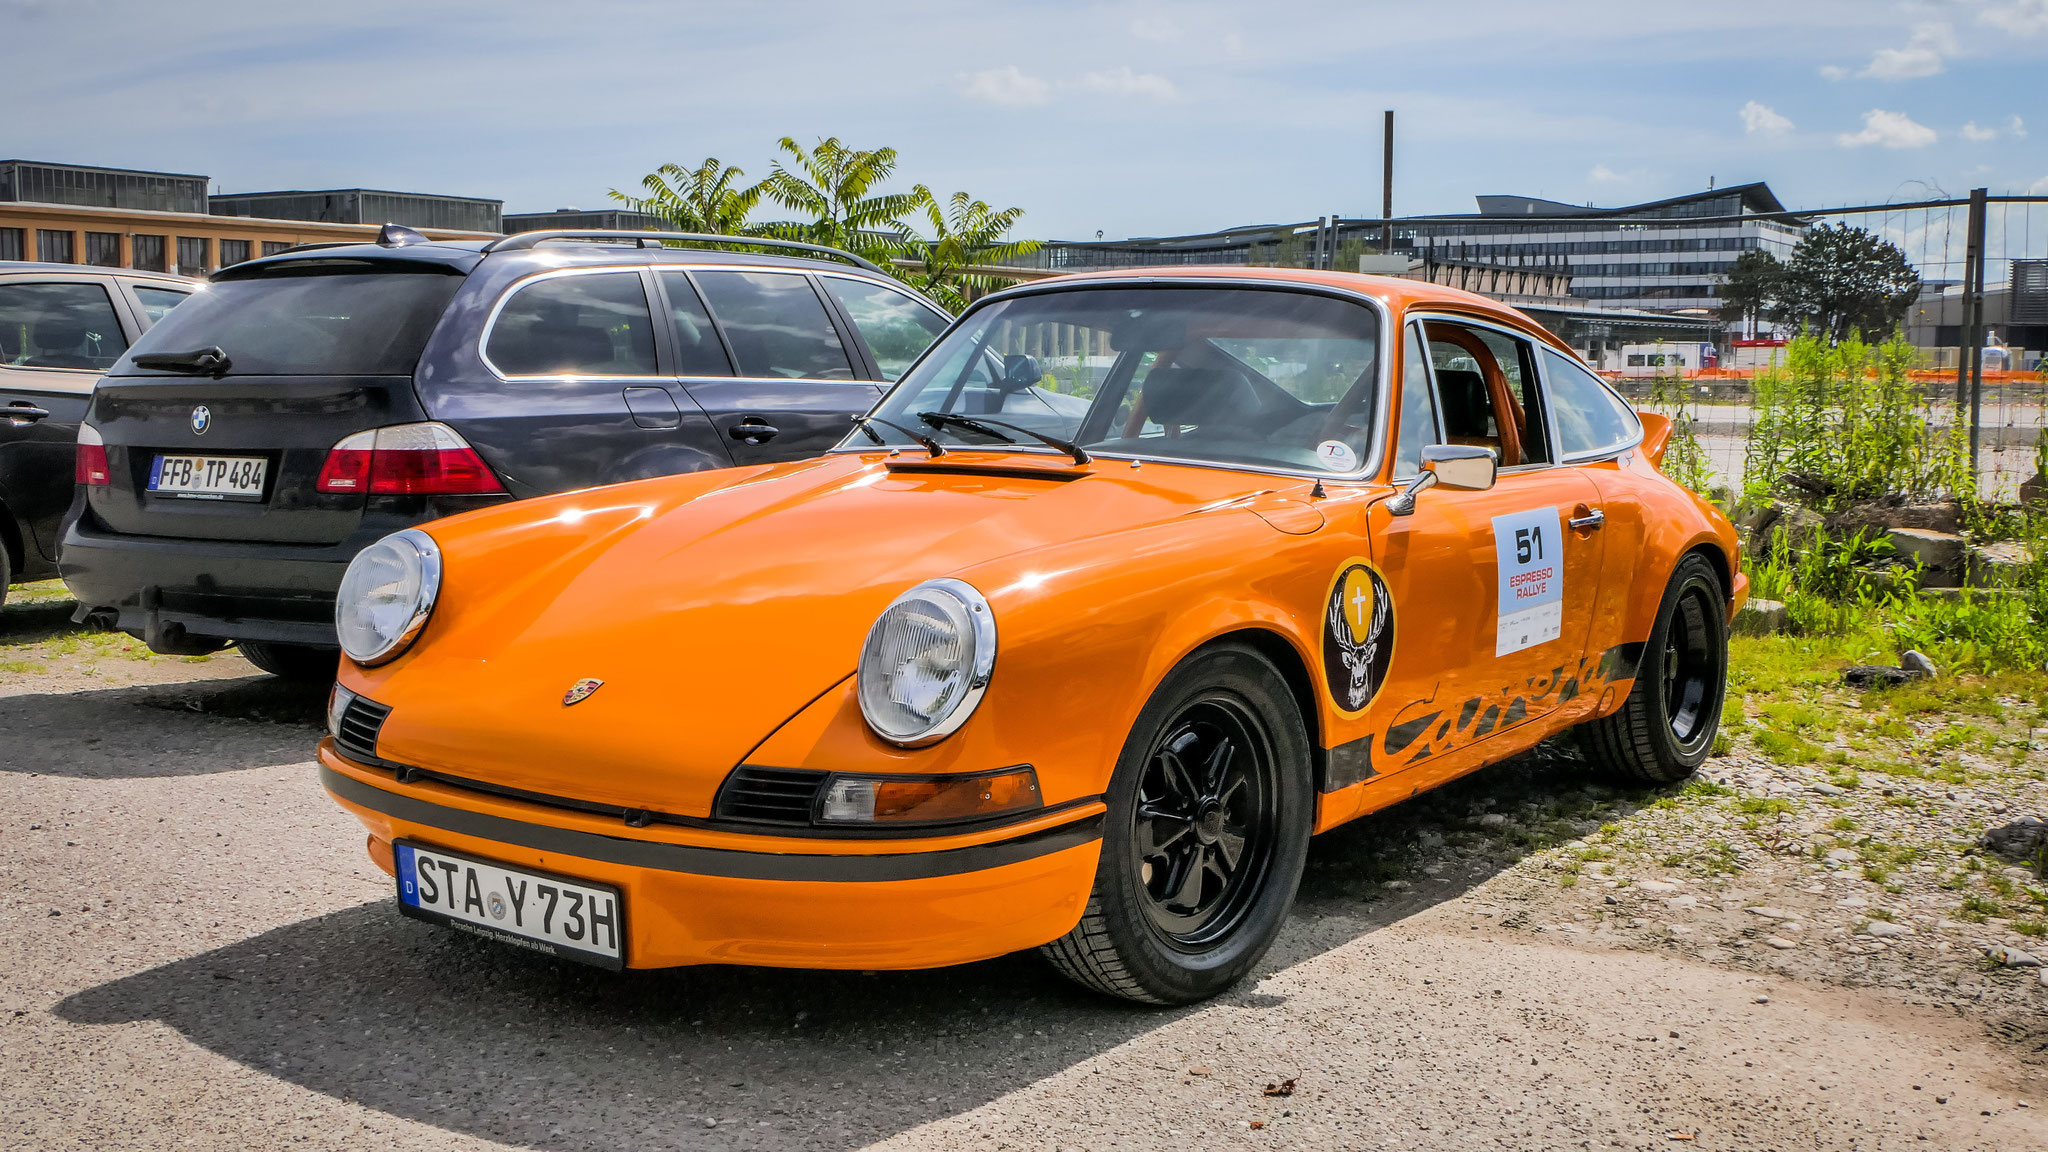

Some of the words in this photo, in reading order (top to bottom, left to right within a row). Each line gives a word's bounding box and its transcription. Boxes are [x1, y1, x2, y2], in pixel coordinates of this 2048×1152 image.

[160, 459, 192, 486] FFB
[206, 460, 227, 487] TP
[229, 461, 261, 489] 484
[1515, 526, 1543, 564] 51
[1510, 567, 1553, 588] ESPRESSO
[1516, 582, 1547, 600] RALLYE
[405, 881, 413, 894] D
[418, 856, 485, 917] STA
[505, 876, 527, 927] Y
[537, 884, 616, 949] 73H
[450, 918, 473, 933] Porsche
[531, 941, 538, 950] ab
[539, 943, 557, 955] Werk.
